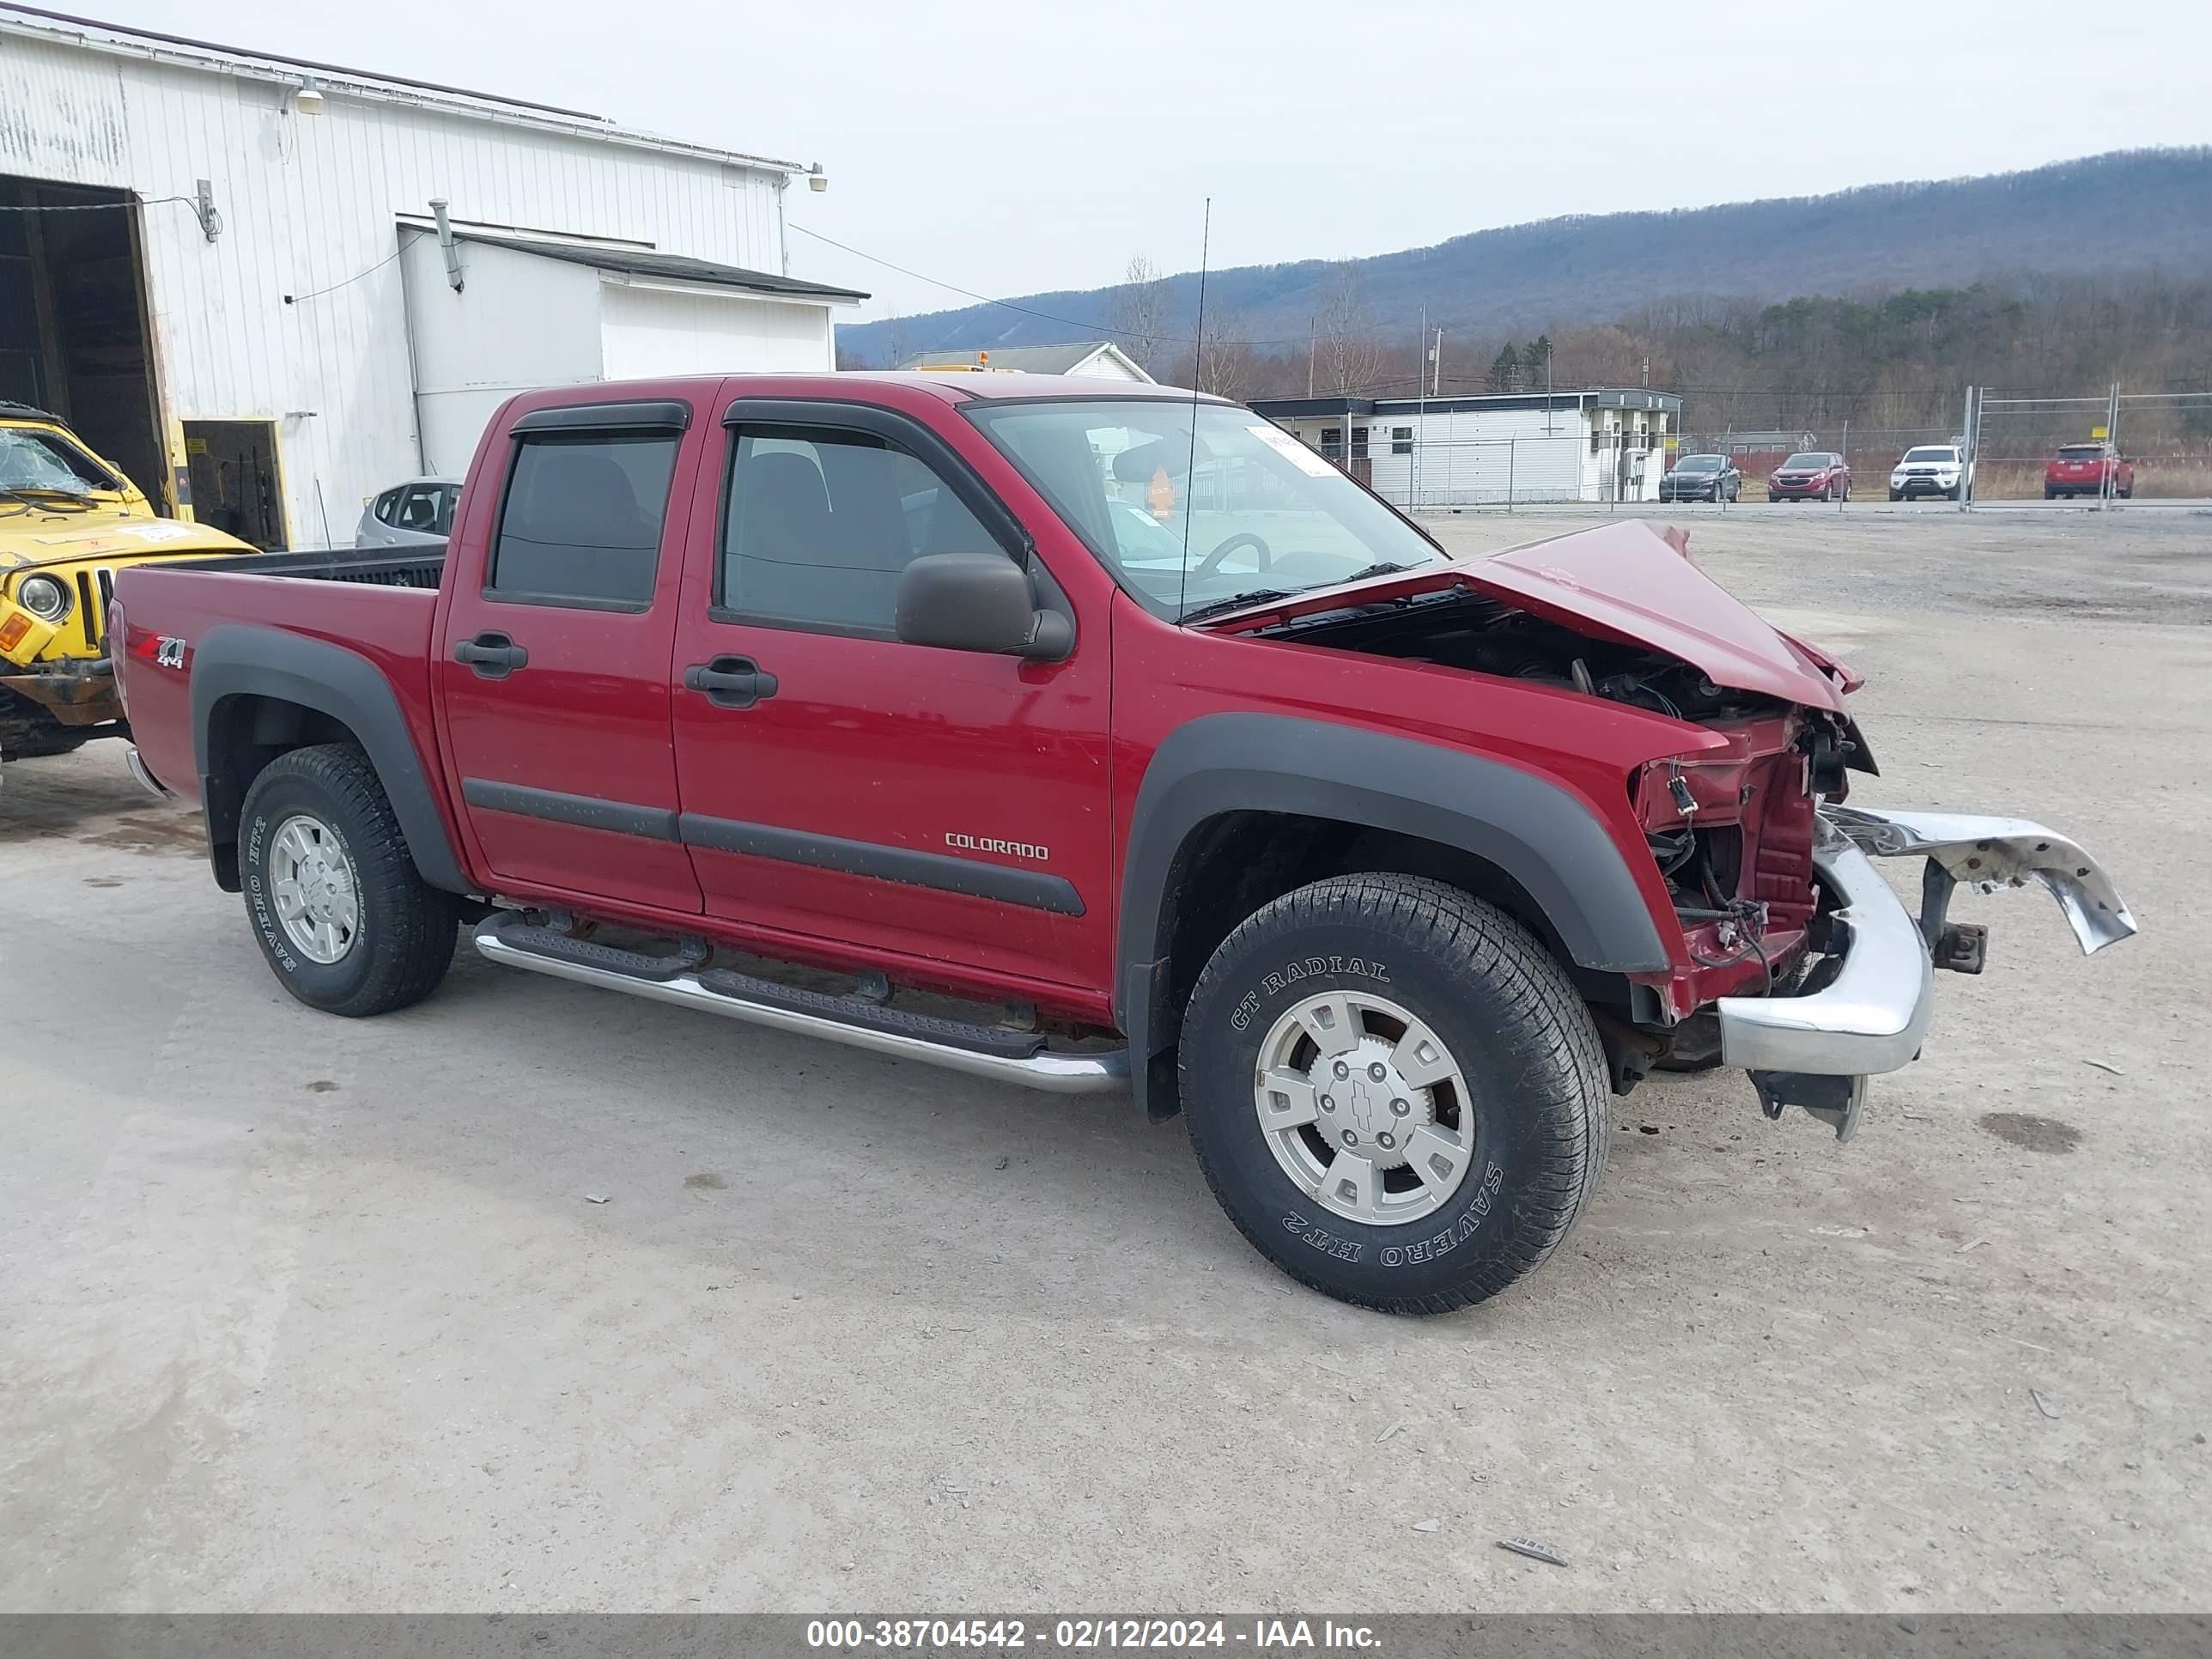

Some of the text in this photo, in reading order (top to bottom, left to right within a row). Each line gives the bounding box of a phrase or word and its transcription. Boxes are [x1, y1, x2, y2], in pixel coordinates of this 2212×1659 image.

[945, 832, 1049, 860] COLORADO
[250, 874, 297, 973] SAVERO
[1231, 956, 1391, 1031] GT RADIAL
[1282, 1161, 1504, 1267] SAVERO HT2
